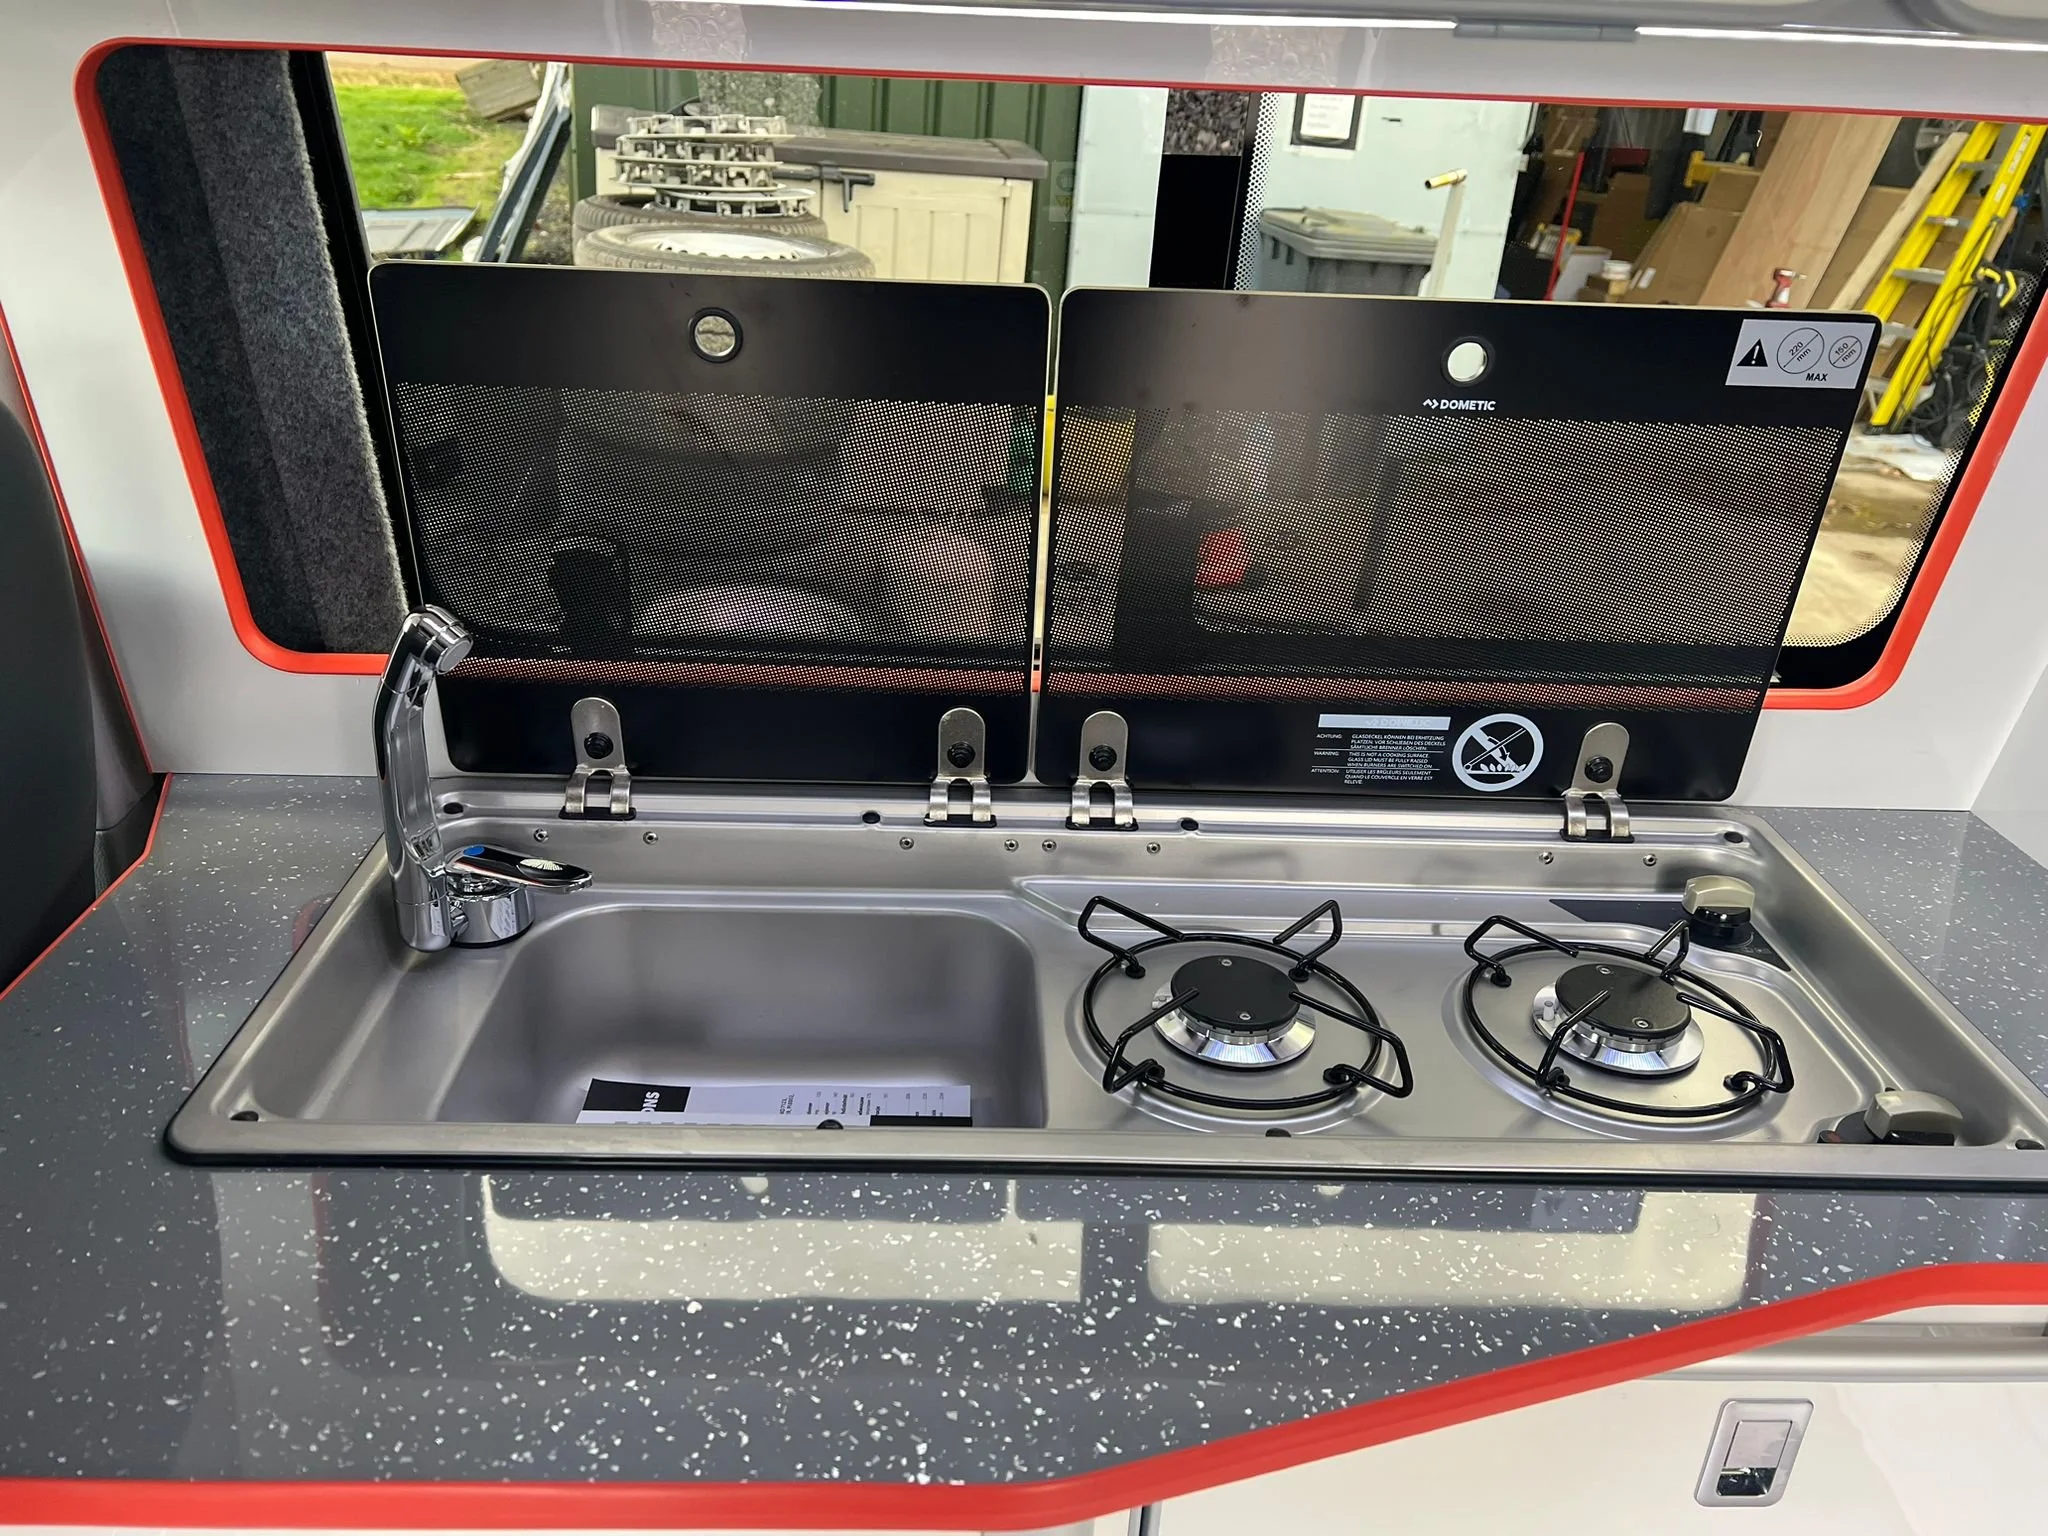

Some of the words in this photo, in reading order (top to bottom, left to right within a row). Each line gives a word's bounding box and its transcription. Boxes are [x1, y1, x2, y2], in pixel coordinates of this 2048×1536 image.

[1788, 341, 1804, 357] 220
[1796, 347, 1812, 363] mm
[1834, 342, 1849, 357] 150
[1841, 348, 1857, 363] mm
[1805, 372, 1829, 382] MAX
[1439, 399, 1497, 411] DOMETIC
